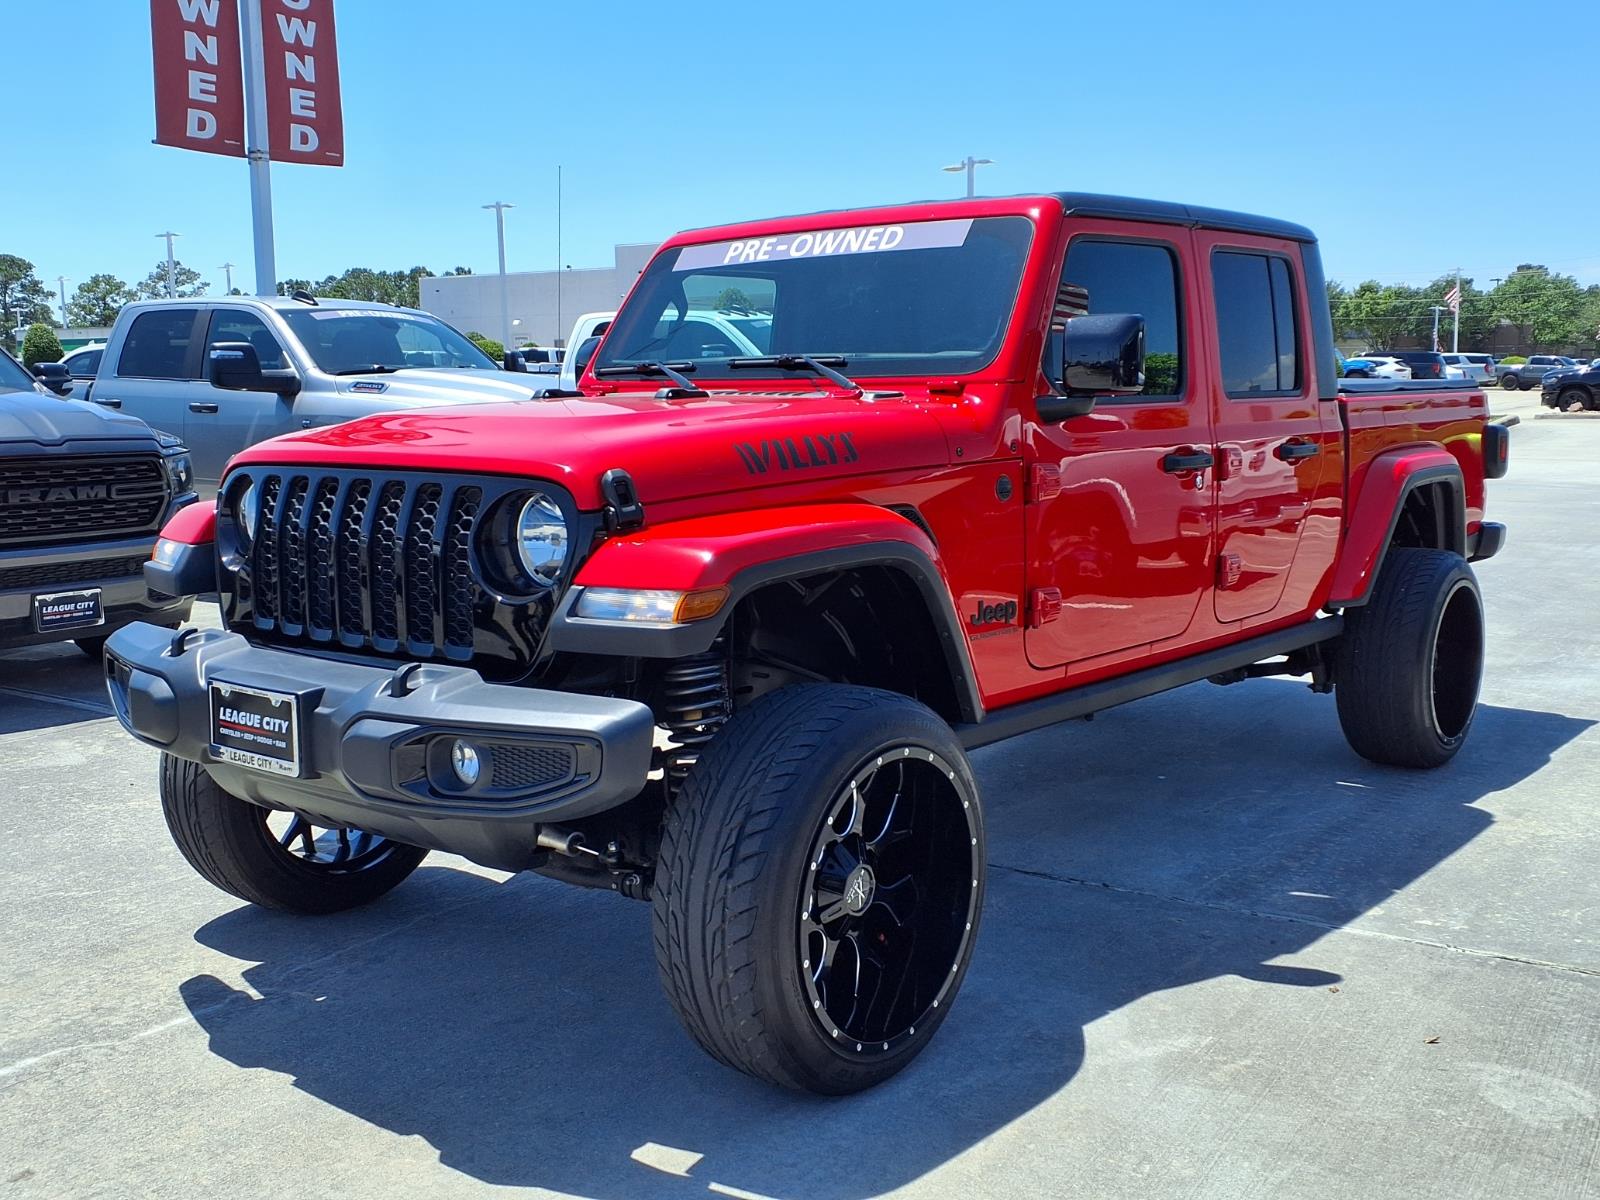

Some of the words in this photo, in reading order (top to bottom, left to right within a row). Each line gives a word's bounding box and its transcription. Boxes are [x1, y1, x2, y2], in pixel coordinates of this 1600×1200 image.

[276, 0, 319, 152] WNED
[723, 226, 904, 264] PRE-OWNED
[733, 431, 859, 475] WILLYS
[8, 485, 107, 504] RAM
[42, 603, 75, 613] LEAGUE
[76, 601, 95, 610] CITY
[970, 600, 1017, 626] Jeep
[219, 707, 261, 728] LEAGUE
[262, 717, 289, 734] CITY
[229, 751, 256, 766] LEAGUE
[257, 757, 273, 769] CITY
